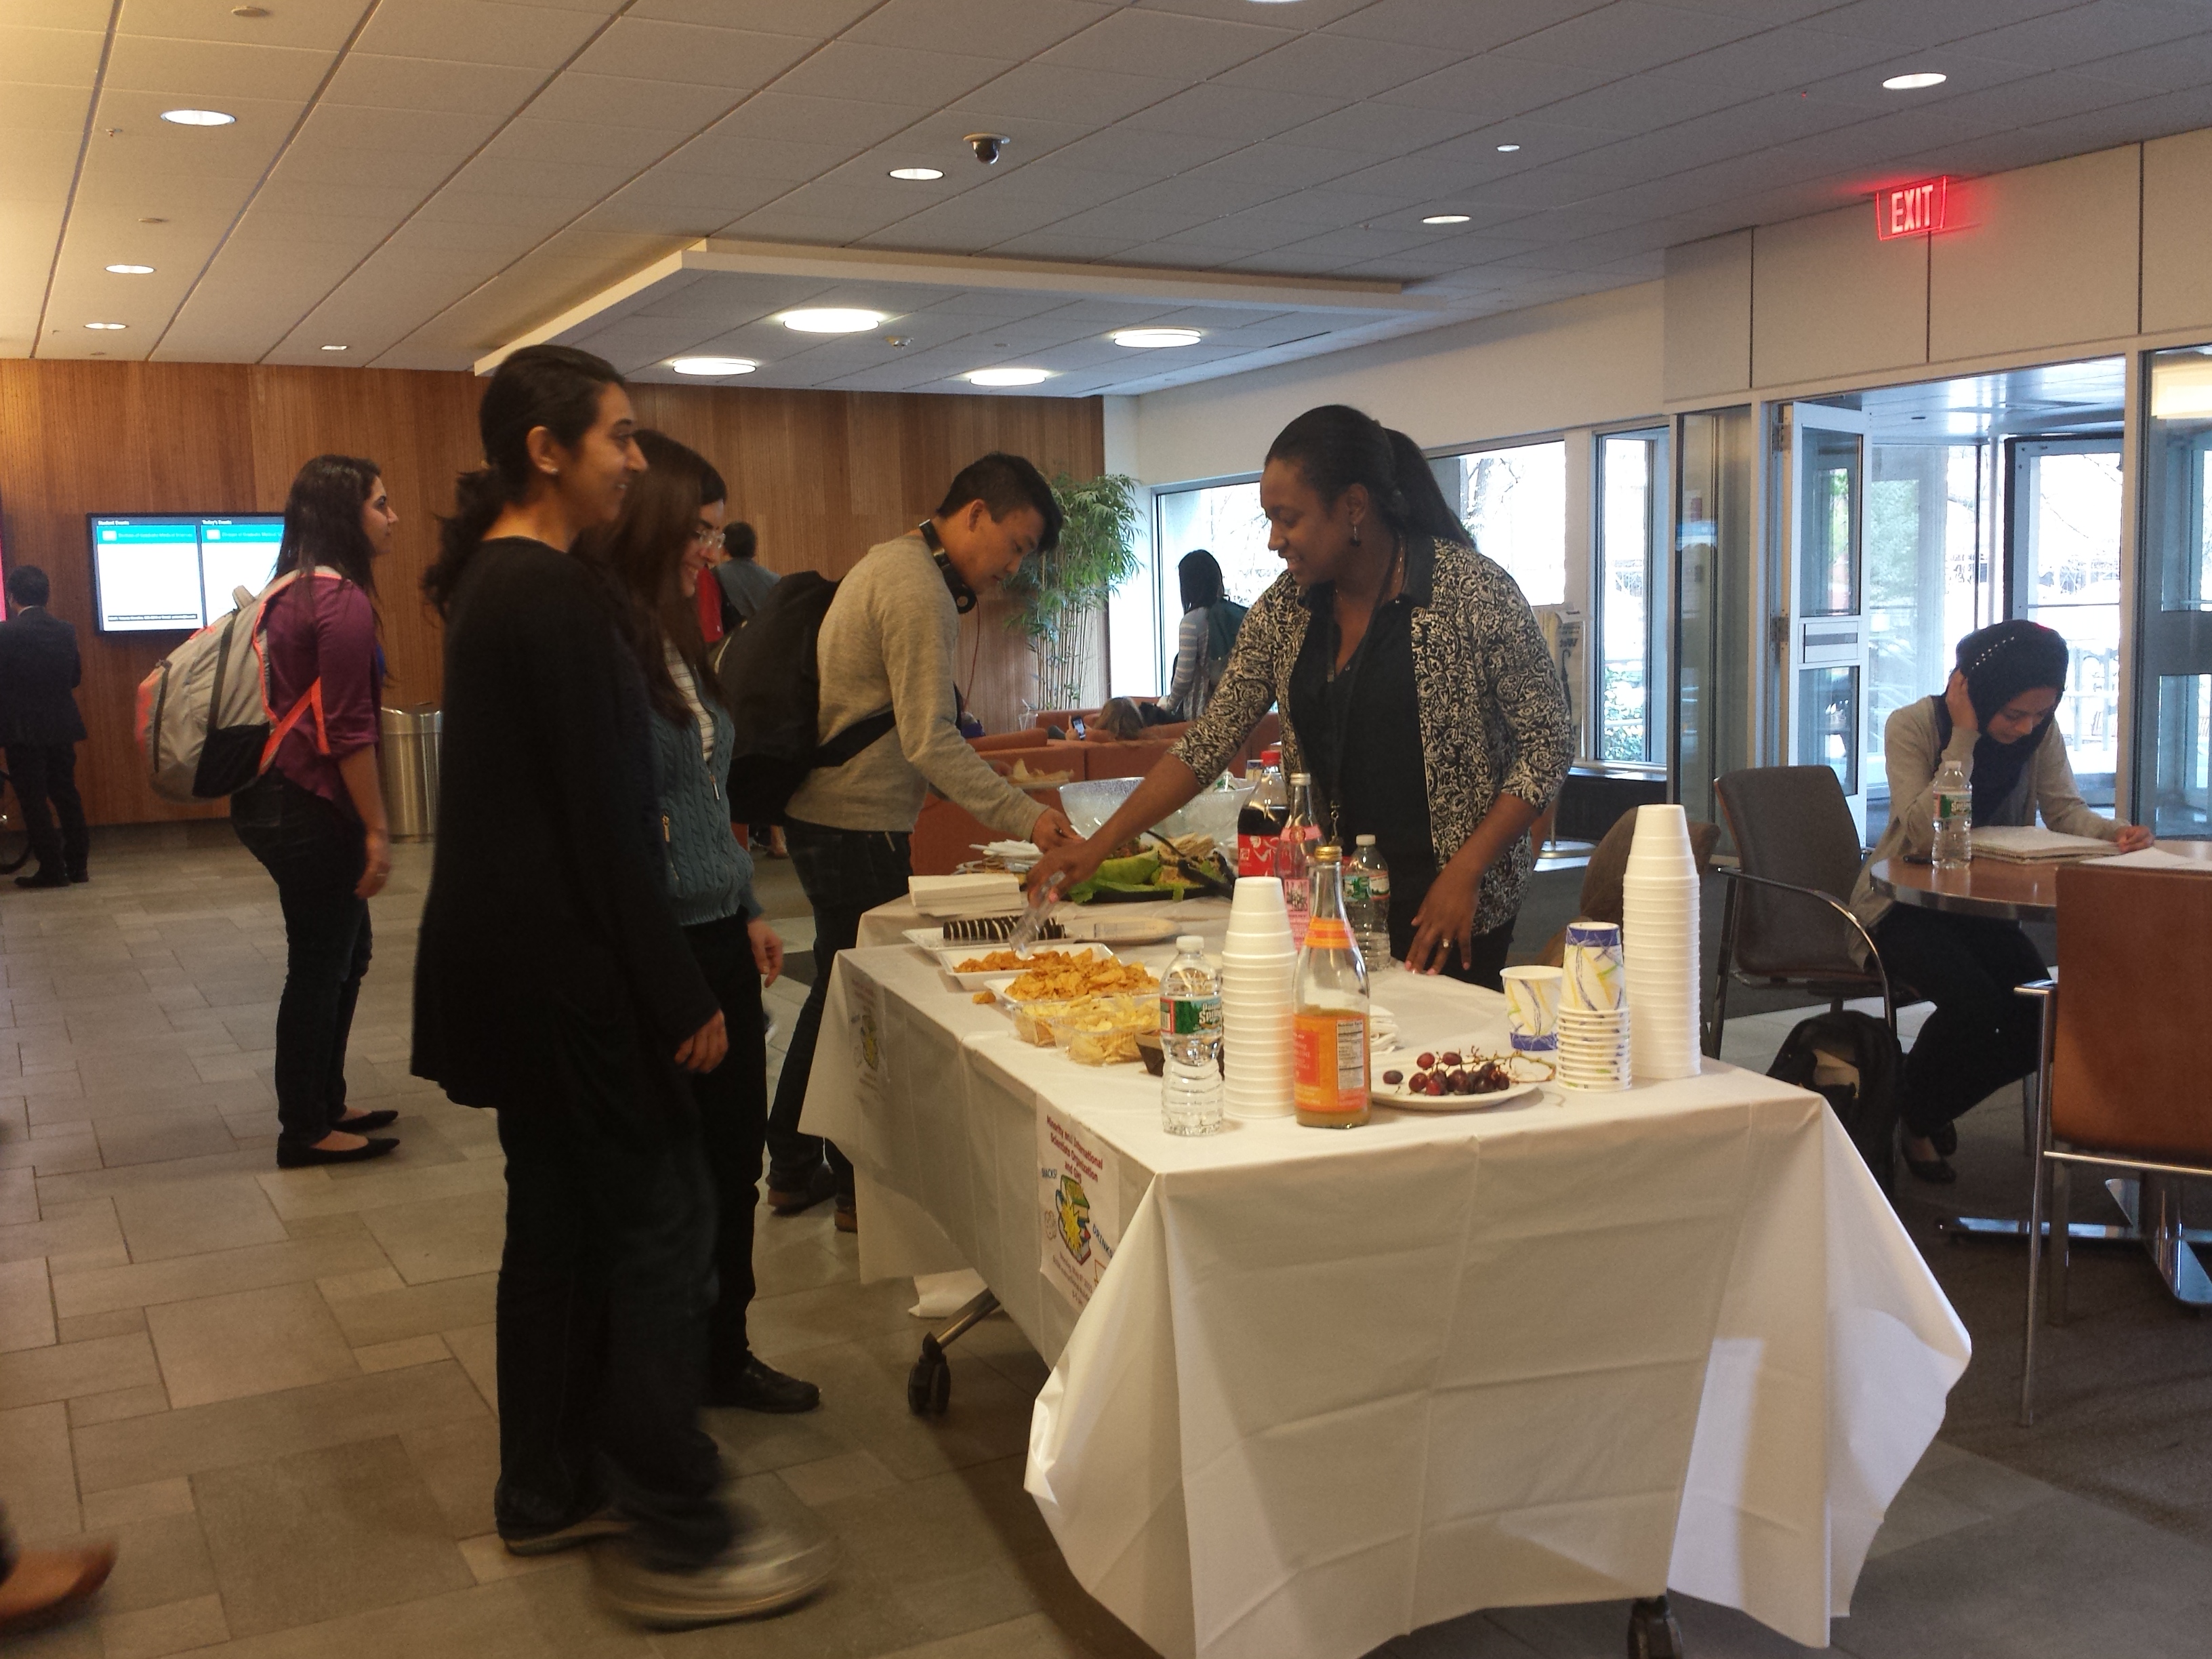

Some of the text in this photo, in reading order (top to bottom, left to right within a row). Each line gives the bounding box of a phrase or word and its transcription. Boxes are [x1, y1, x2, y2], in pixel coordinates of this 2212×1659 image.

[1891, 184, 1933, 234] EXIT
[1046, 1114, 1103, 1170] Minority and International
[1050, 1132, 1098, 1183] Scientists Organization
[1065, 1161, 1073, 1174] and
